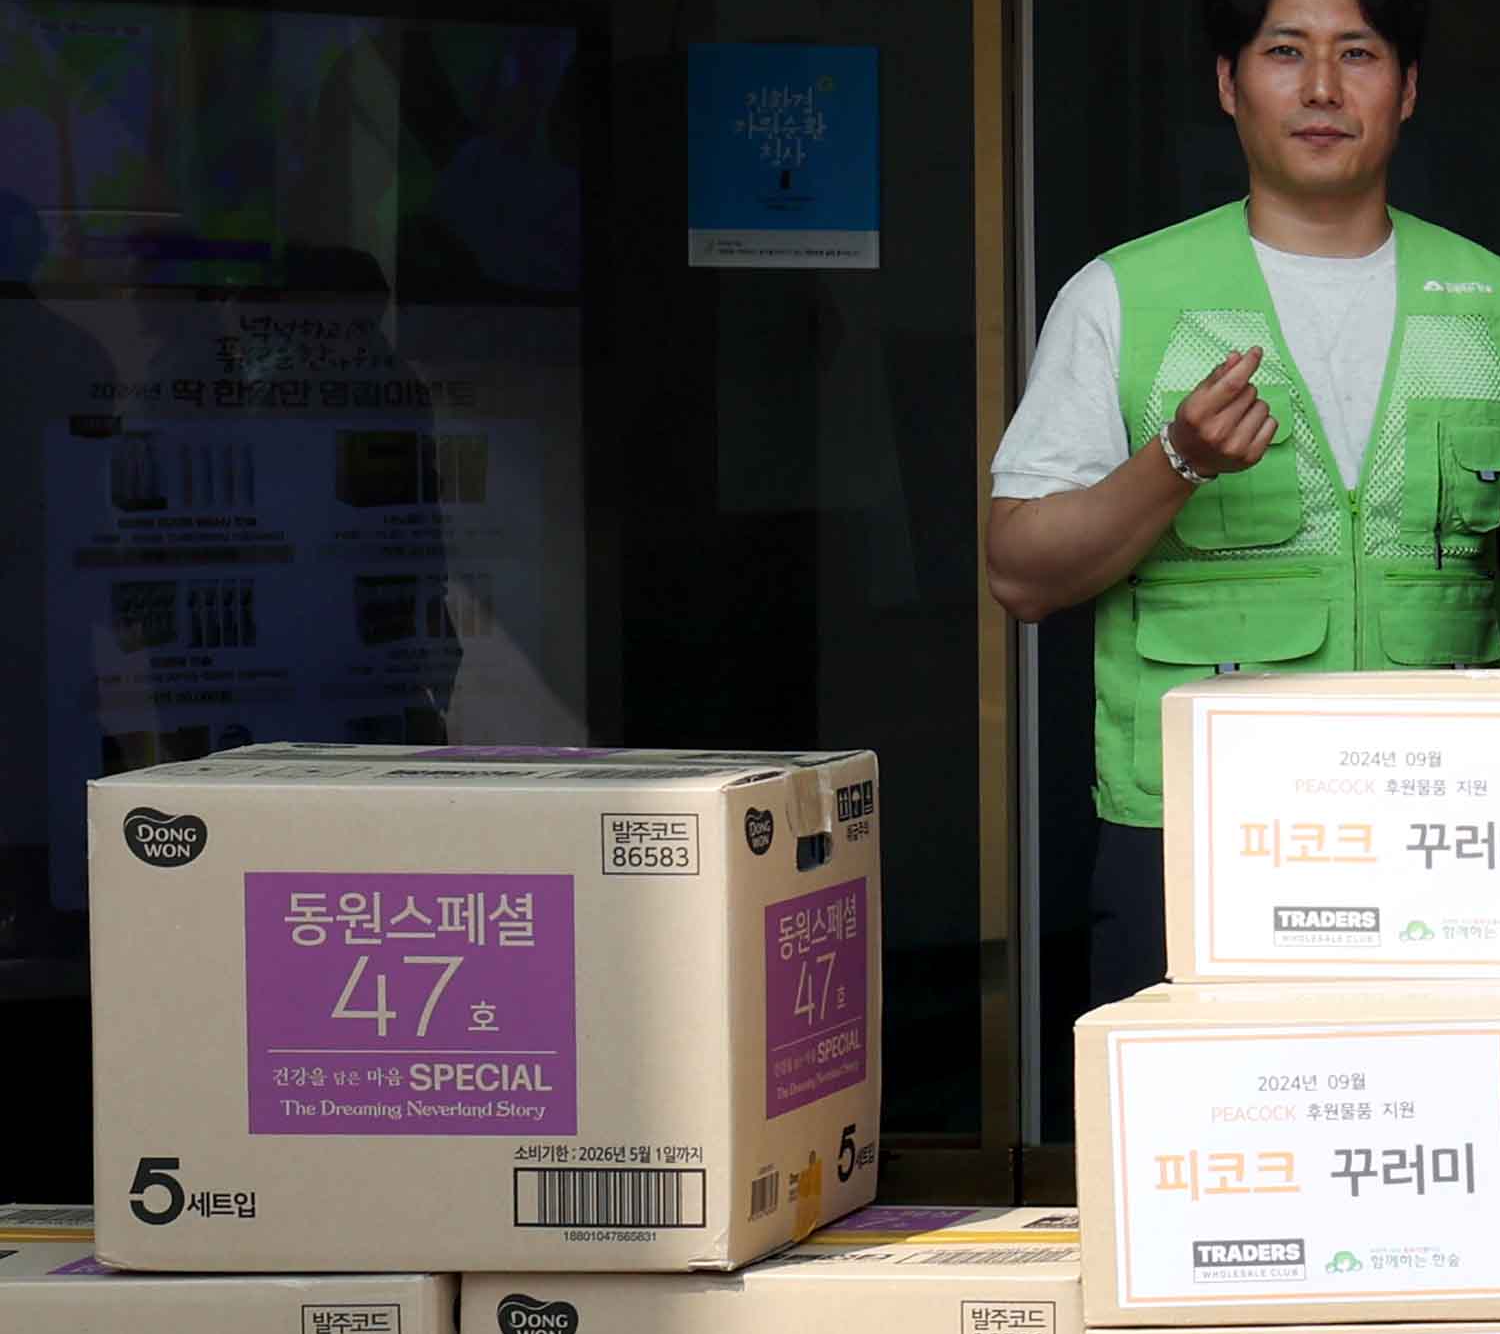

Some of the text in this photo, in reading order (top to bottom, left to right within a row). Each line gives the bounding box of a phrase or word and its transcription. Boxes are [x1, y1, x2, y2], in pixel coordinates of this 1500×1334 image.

[137, 824, 197, 845] DONG
[612, 820, 690, 844] 발주코드
[144, 842, 191, 859] WON
[612, 847, 690, 867] 86583
[285, 891, 536, 947] 동원스페셜
[272, 1067, 327, 1087] 건강을
[366, 1067, 403, 1087] 마음
[409, 1064, 552, 1092] SPECIAL
[1257, 1072, 1366, 1093] 2024년 09월
[280, 1100, 545, 1121] The Dreaming Neverland Story
[1211, 1100, 1416, 1124] PEACOCK 후원물품 지원
[514, 1145, 703, 1163] 소비기한 2026년 5월 1일까지
[1153, 1142, 1476, 1203] 피코크 꾸러미
[1198, 1243, 1301, 1265] TRADERS
[1370, 1251, 1461, 1271] 함께하는 한숲
[1201, 1268, 1299, 1280] WHOLESALE CLUB
